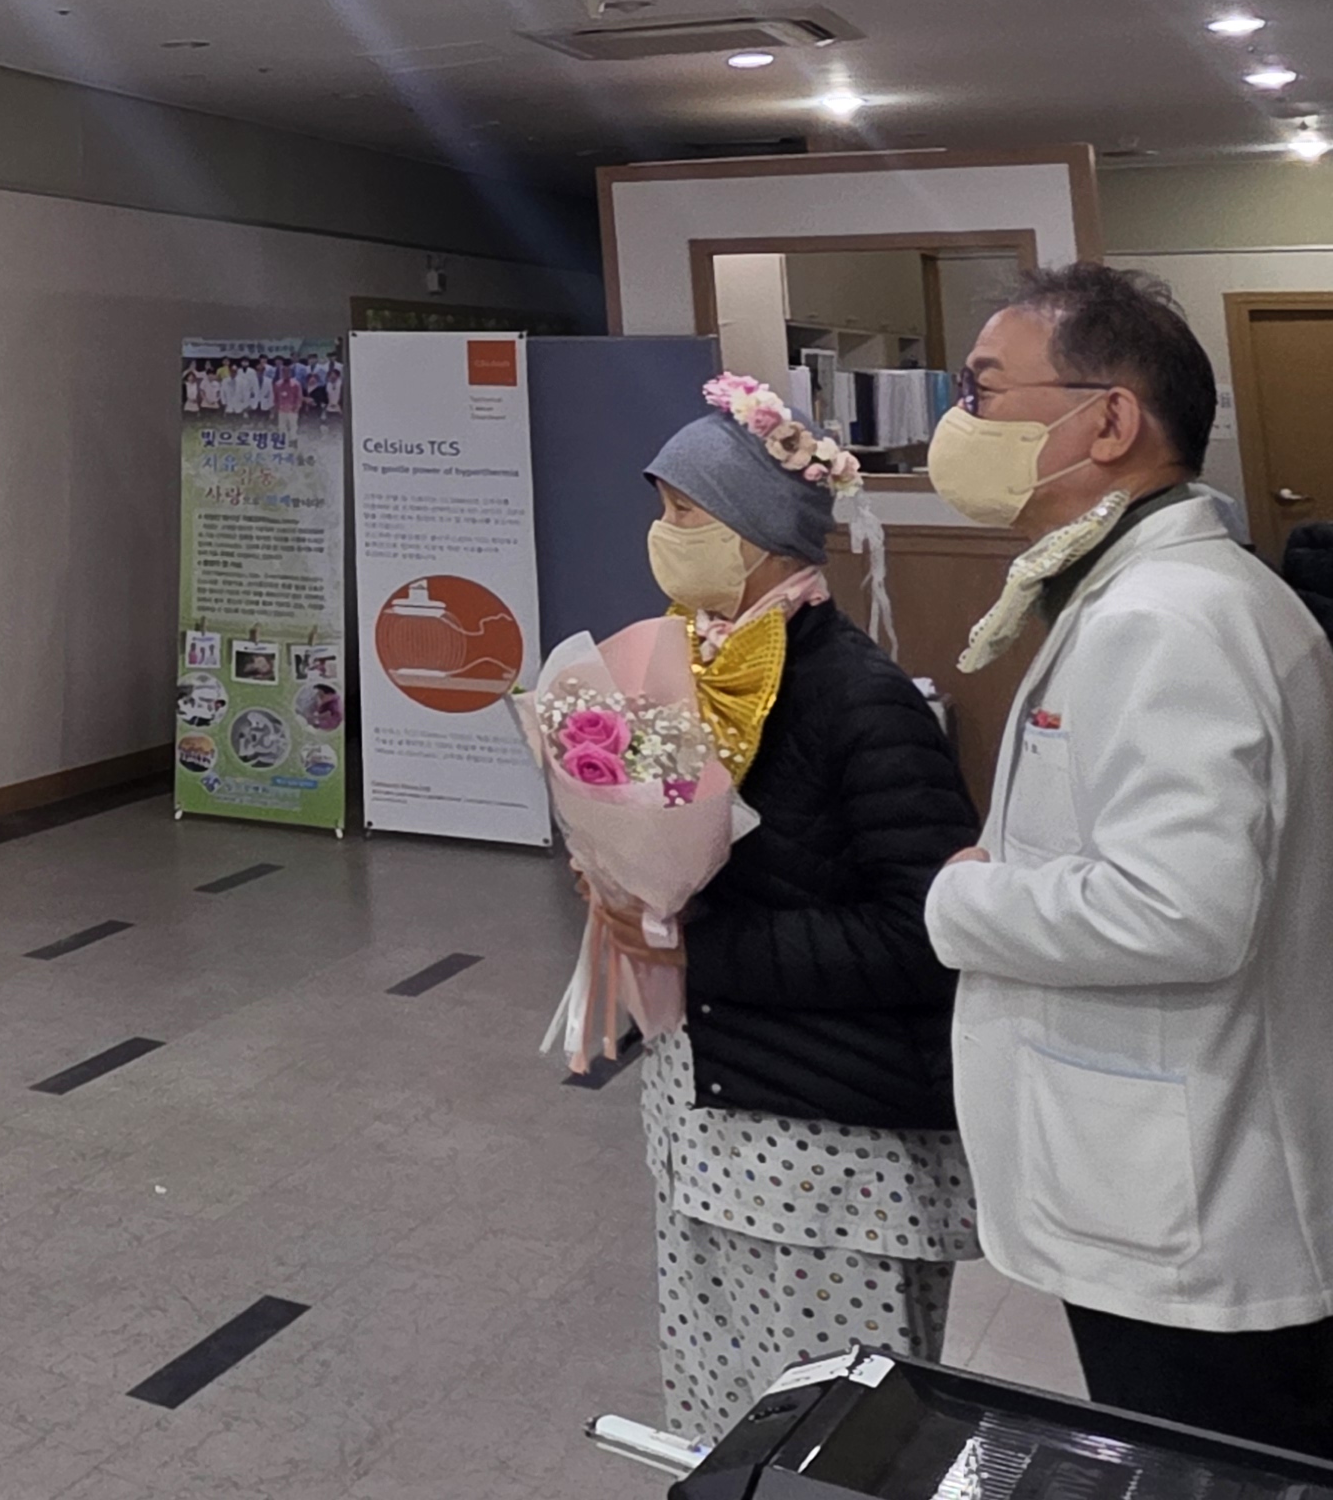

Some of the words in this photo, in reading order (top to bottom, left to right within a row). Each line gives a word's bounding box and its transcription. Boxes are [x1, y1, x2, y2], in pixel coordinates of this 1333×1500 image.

[362, 438, 425, 456] Celsius
[427, 440, 461, 457] TCS
[362, 463, 378, 472] The
[412, 467, 440, 476] power
[443, 466, 453, 475] of
